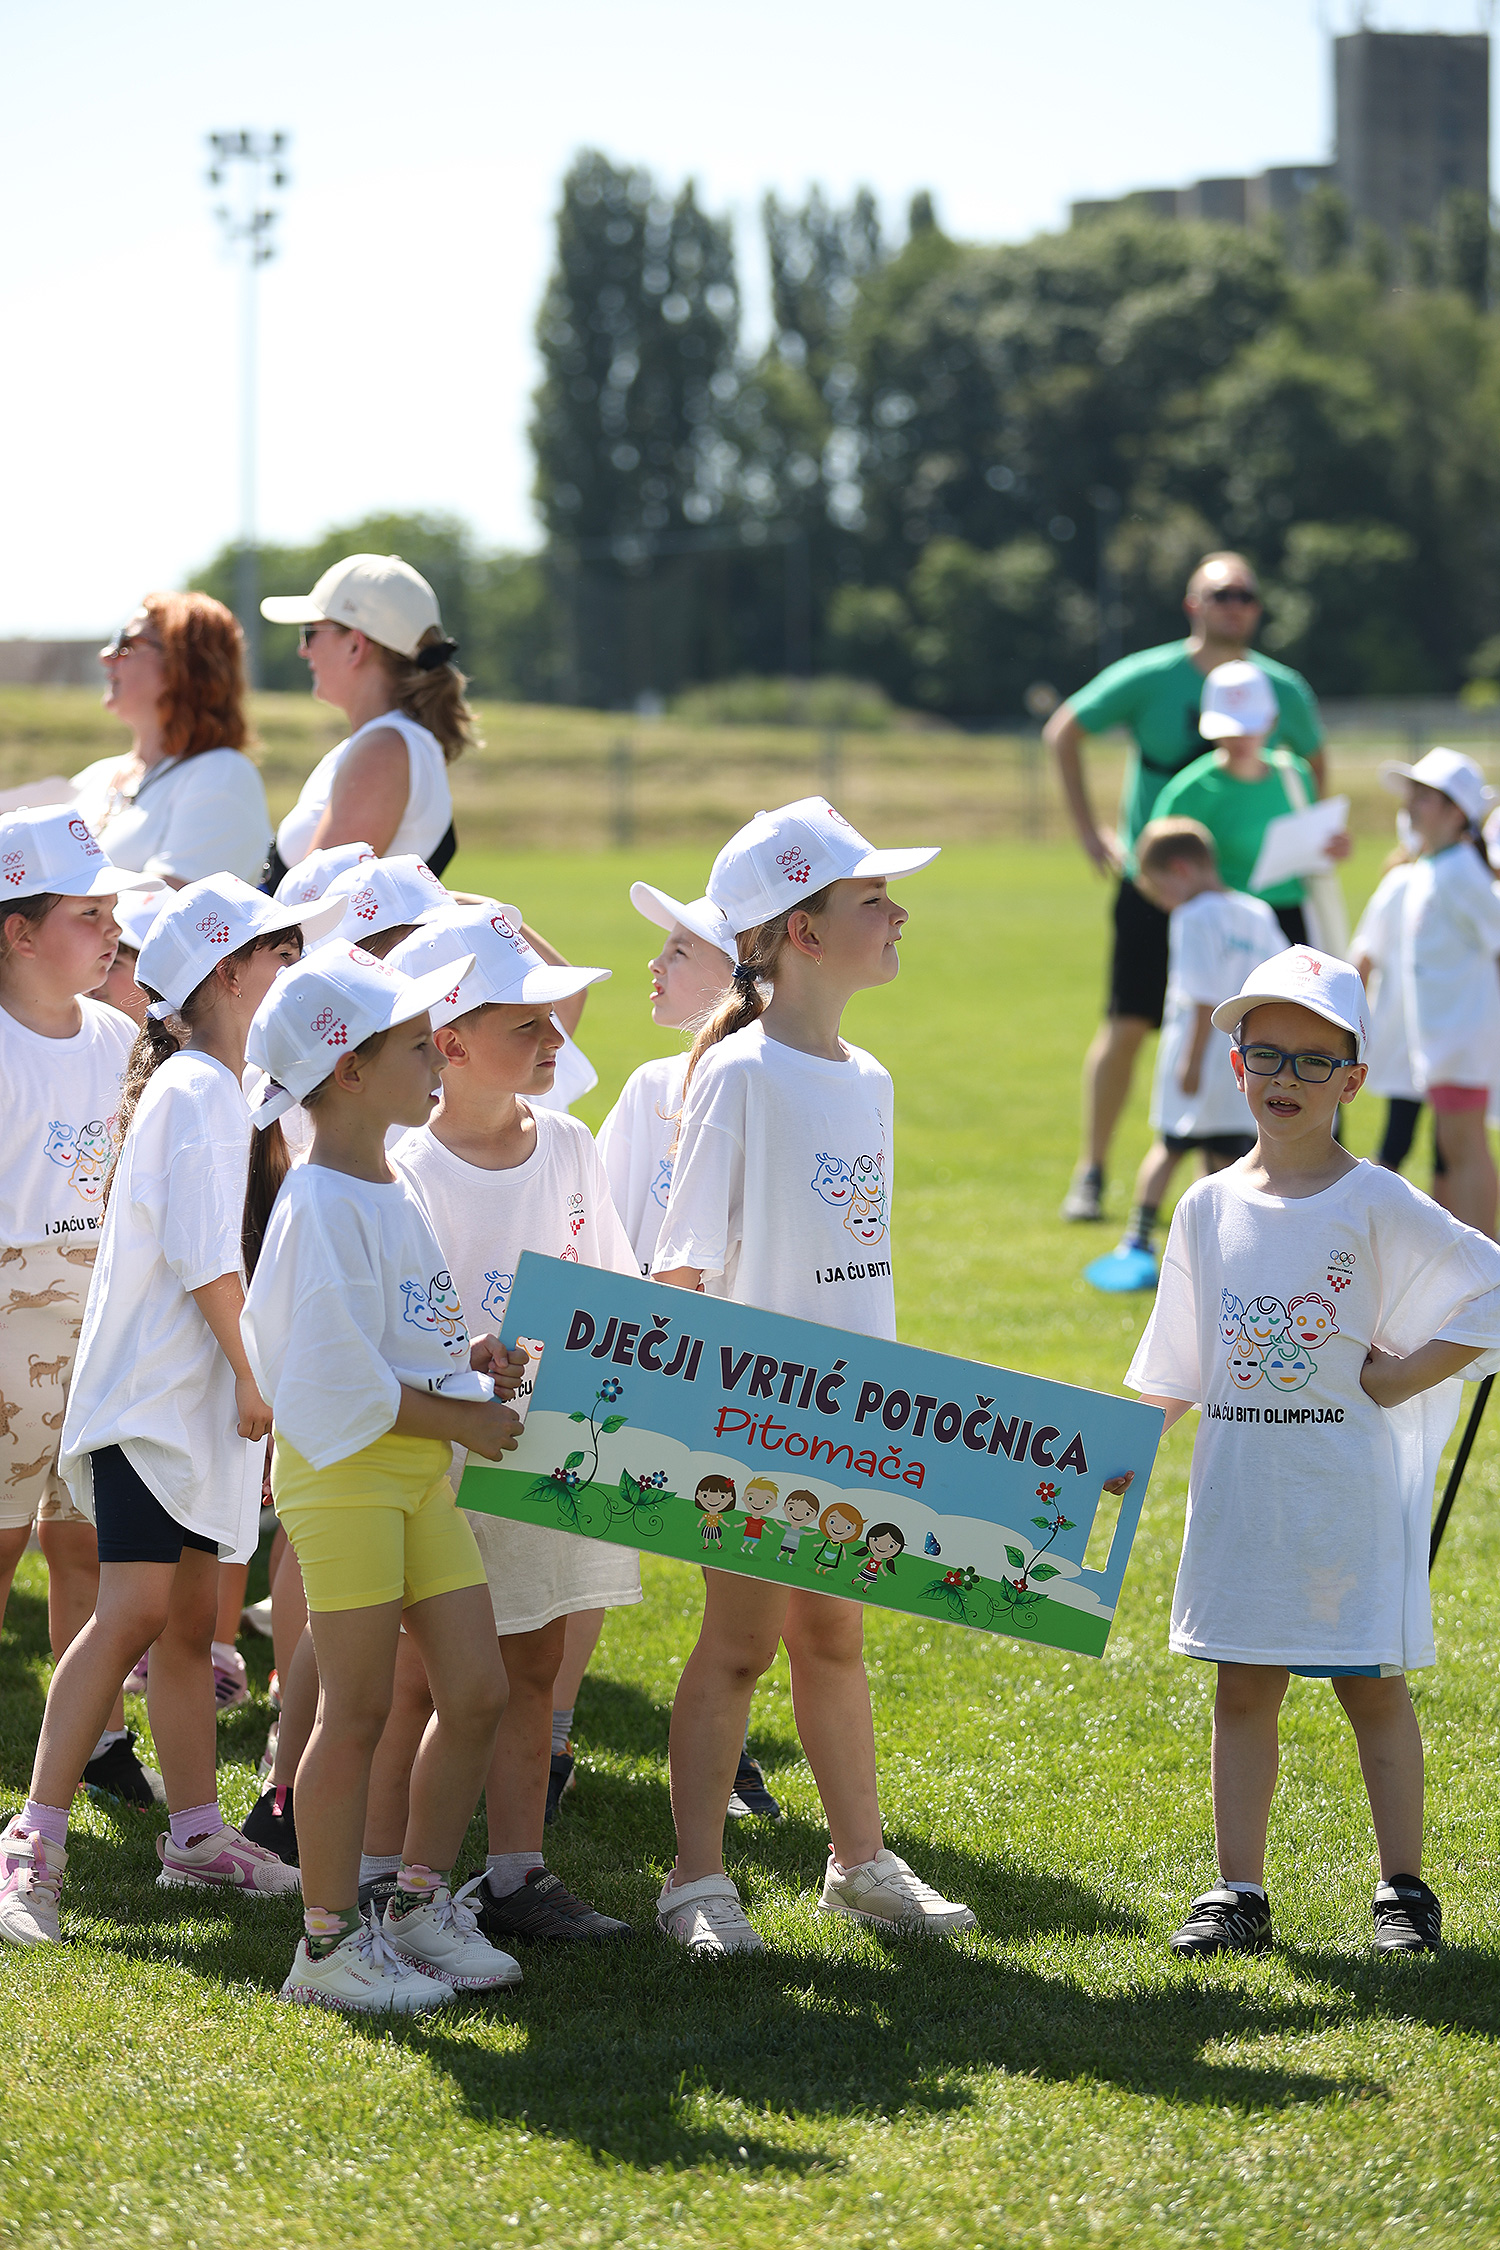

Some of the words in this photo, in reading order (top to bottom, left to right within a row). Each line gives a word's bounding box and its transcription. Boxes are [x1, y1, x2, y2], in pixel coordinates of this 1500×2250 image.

[815, 1269, 822, 1284] I
[824, 1266, 846, 1283] JA
[847, 1261, 866, 1281] ĆU
[867, 1260, 891, 1278] BITI
[564, 1309, 705, 1382] DJEČJI
[719, 1345, 847, 1415] VRTIĆ
[853, 1380, 1089, 1476] POTOČNICA
[1211, 1403, 1222, 1420] JA
[1222, 1401, 1234, 1421] ĆU
[1236, 1406, 1260, 1424] BITI
[1263, 1408, 1345, 1424] OLIMPIJAC
[714, 1405, 927, 1489] Pitomača
